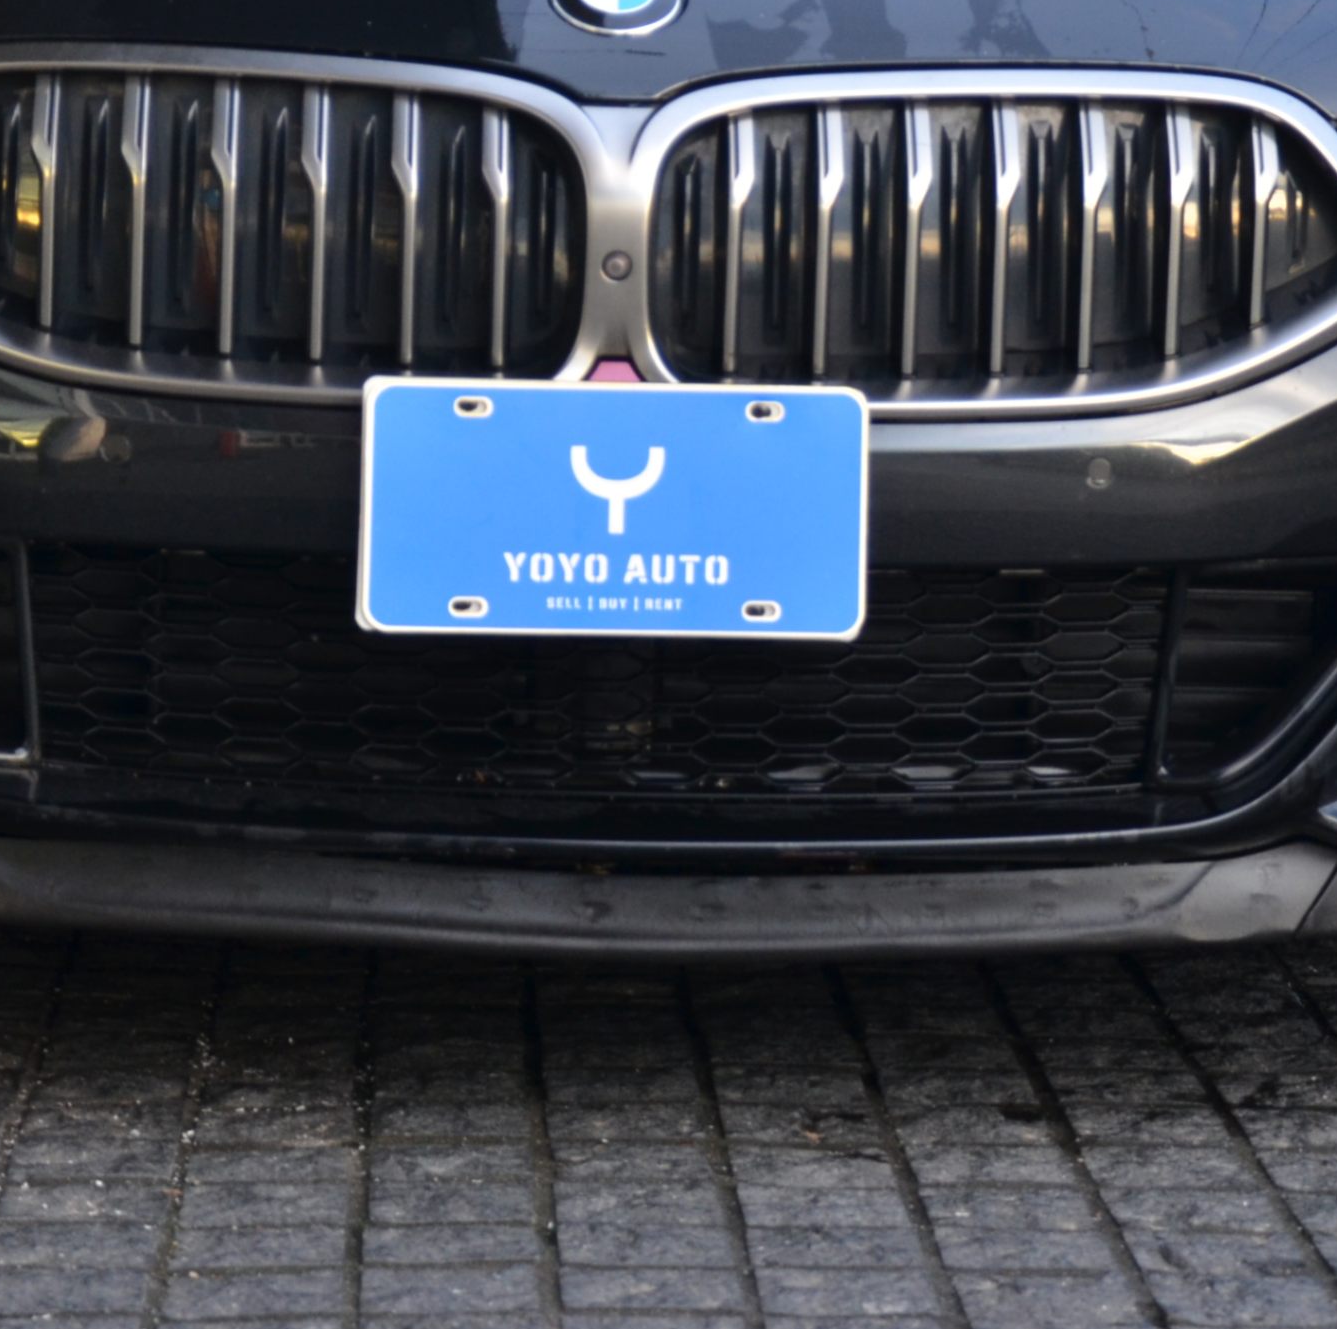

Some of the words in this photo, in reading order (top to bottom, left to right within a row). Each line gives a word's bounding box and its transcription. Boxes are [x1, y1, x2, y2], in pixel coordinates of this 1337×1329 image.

[502, 551, 610, 584] YOYO
[623, 553, 730, 586] AUTO
[546, 596, 582, 610] SELL
[598, 597, 628, 611] BUY
[644, 598, 683, 611] RENT
